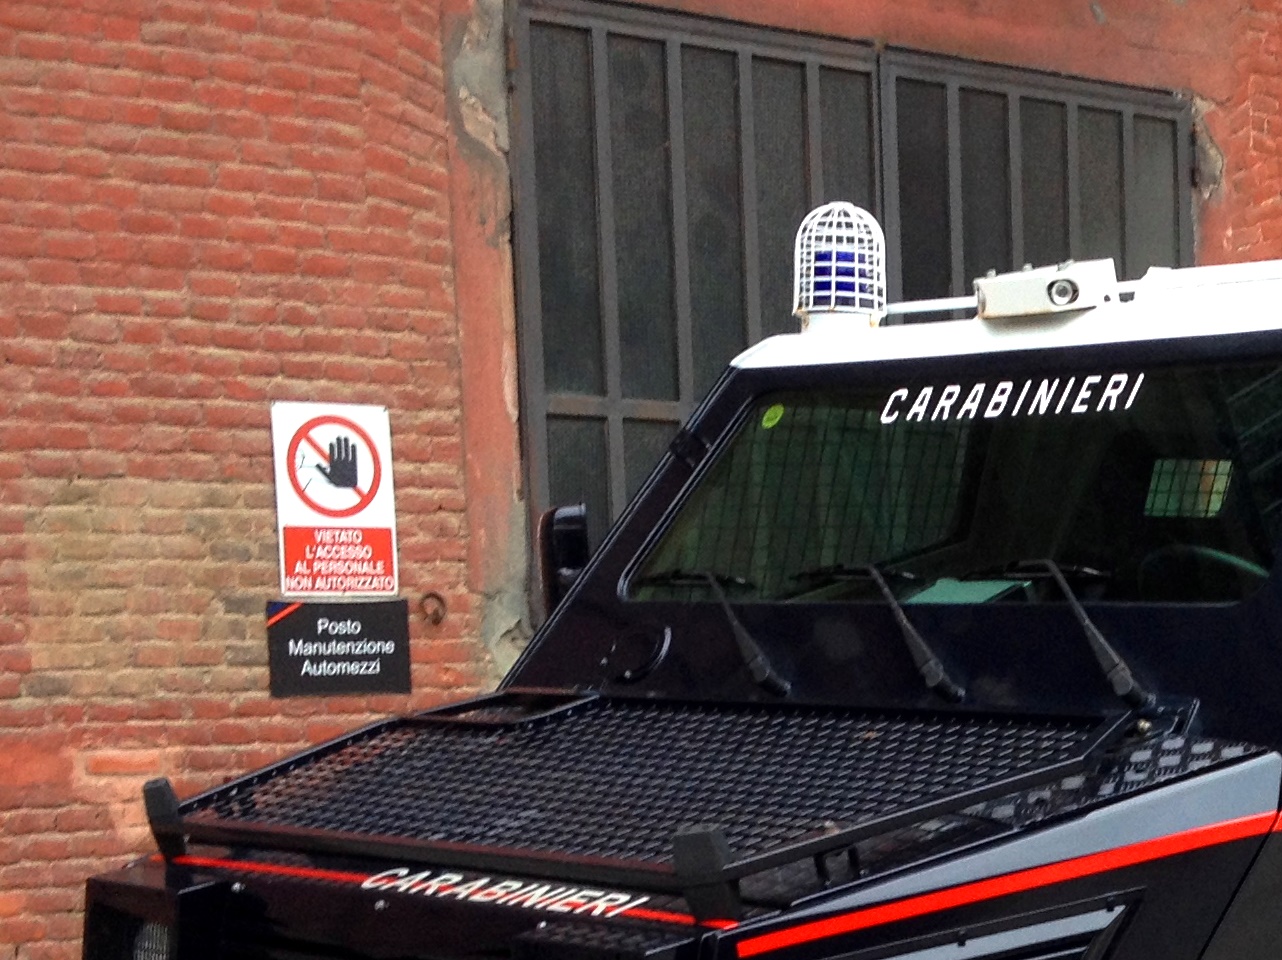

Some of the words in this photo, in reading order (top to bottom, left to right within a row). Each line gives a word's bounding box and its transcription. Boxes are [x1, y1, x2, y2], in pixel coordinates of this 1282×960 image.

[879, 372, 1145, 424] CARABINIERI
[314, 528, 363, 544] VIETATO
[305, 544, 373, 560] L'ACCESSO
[294, 560, 312, 575] AL
[312, 560, 385, 576] PERSONALE
[286, 575, 313, 590] NON
[314, 575, 395, 591] AUTORIZZATO
[317, 617, 362, 635] Posto
[288, 638, 396, 656] Manutenzione
[300, 657, 381, 677] Automezzi
[360, 867, 650, 918] CARABINIERI
